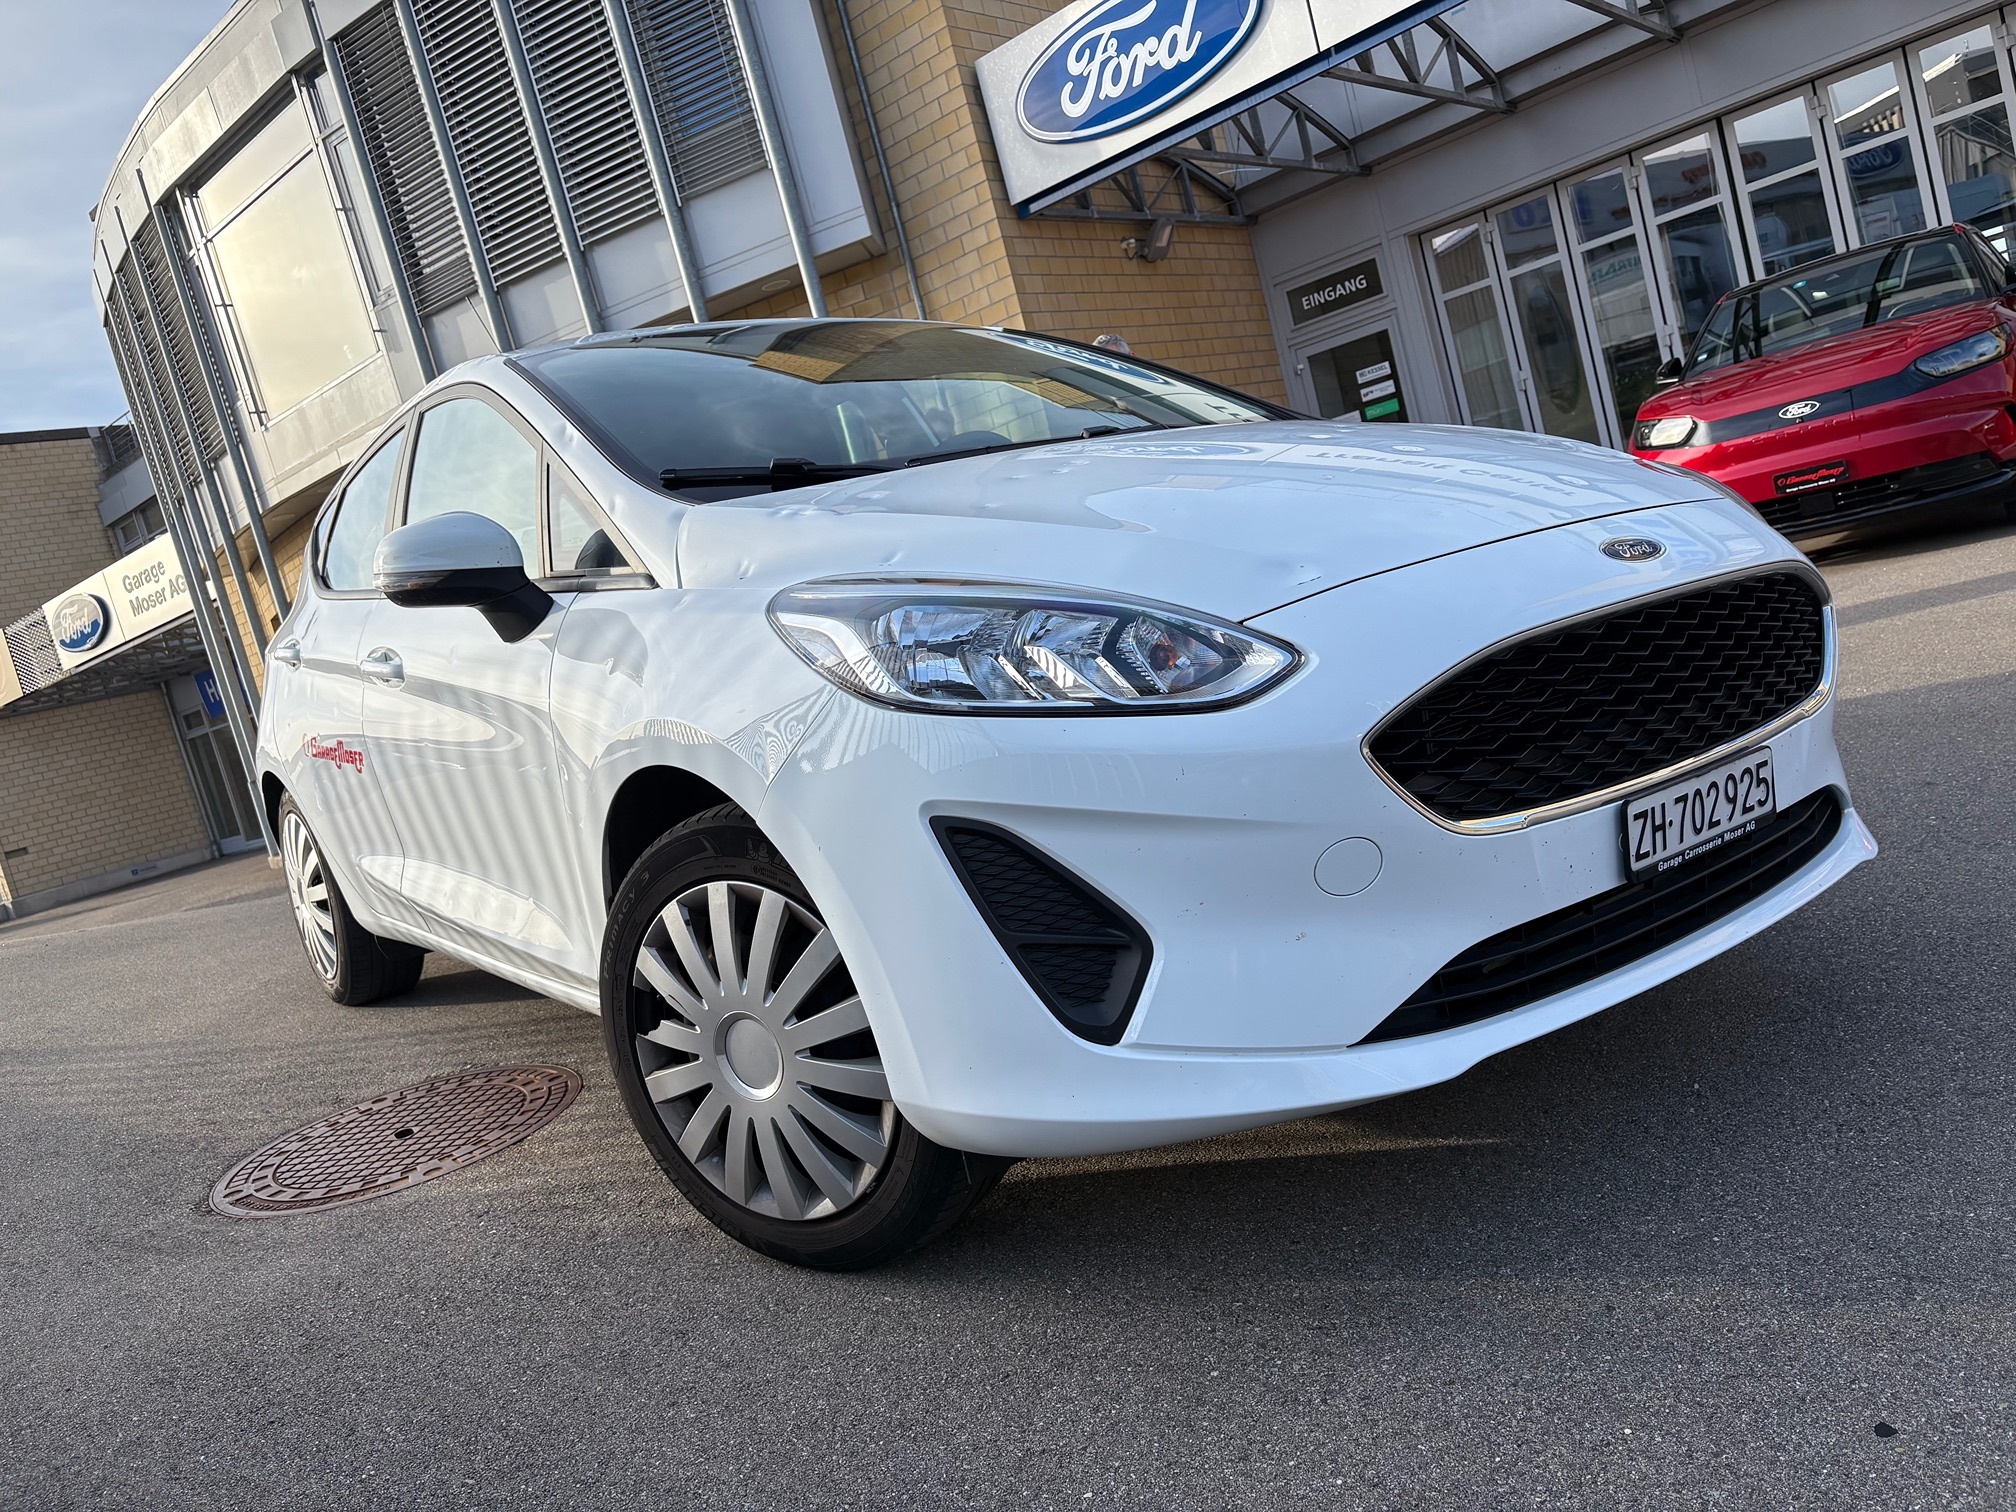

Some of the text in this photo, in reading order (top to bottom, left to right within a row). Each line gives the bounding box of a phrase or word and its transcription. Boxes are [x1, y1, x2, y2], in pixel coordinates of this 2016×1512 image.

[1061, 0, 1202, 117] Ford
[1302, 274, 1368, 311] EINGANG
[1787, 403, 1811, 417] Ford
[1614, 541, 1653, 558] Ford
[122, 560, 166, 594] Garage
[129, 574, 187, 617] Moser AG
[60, 603, 92, 643] Ford
[1657, 820, 1756, 871] Garage Carrosserie Moser AG
